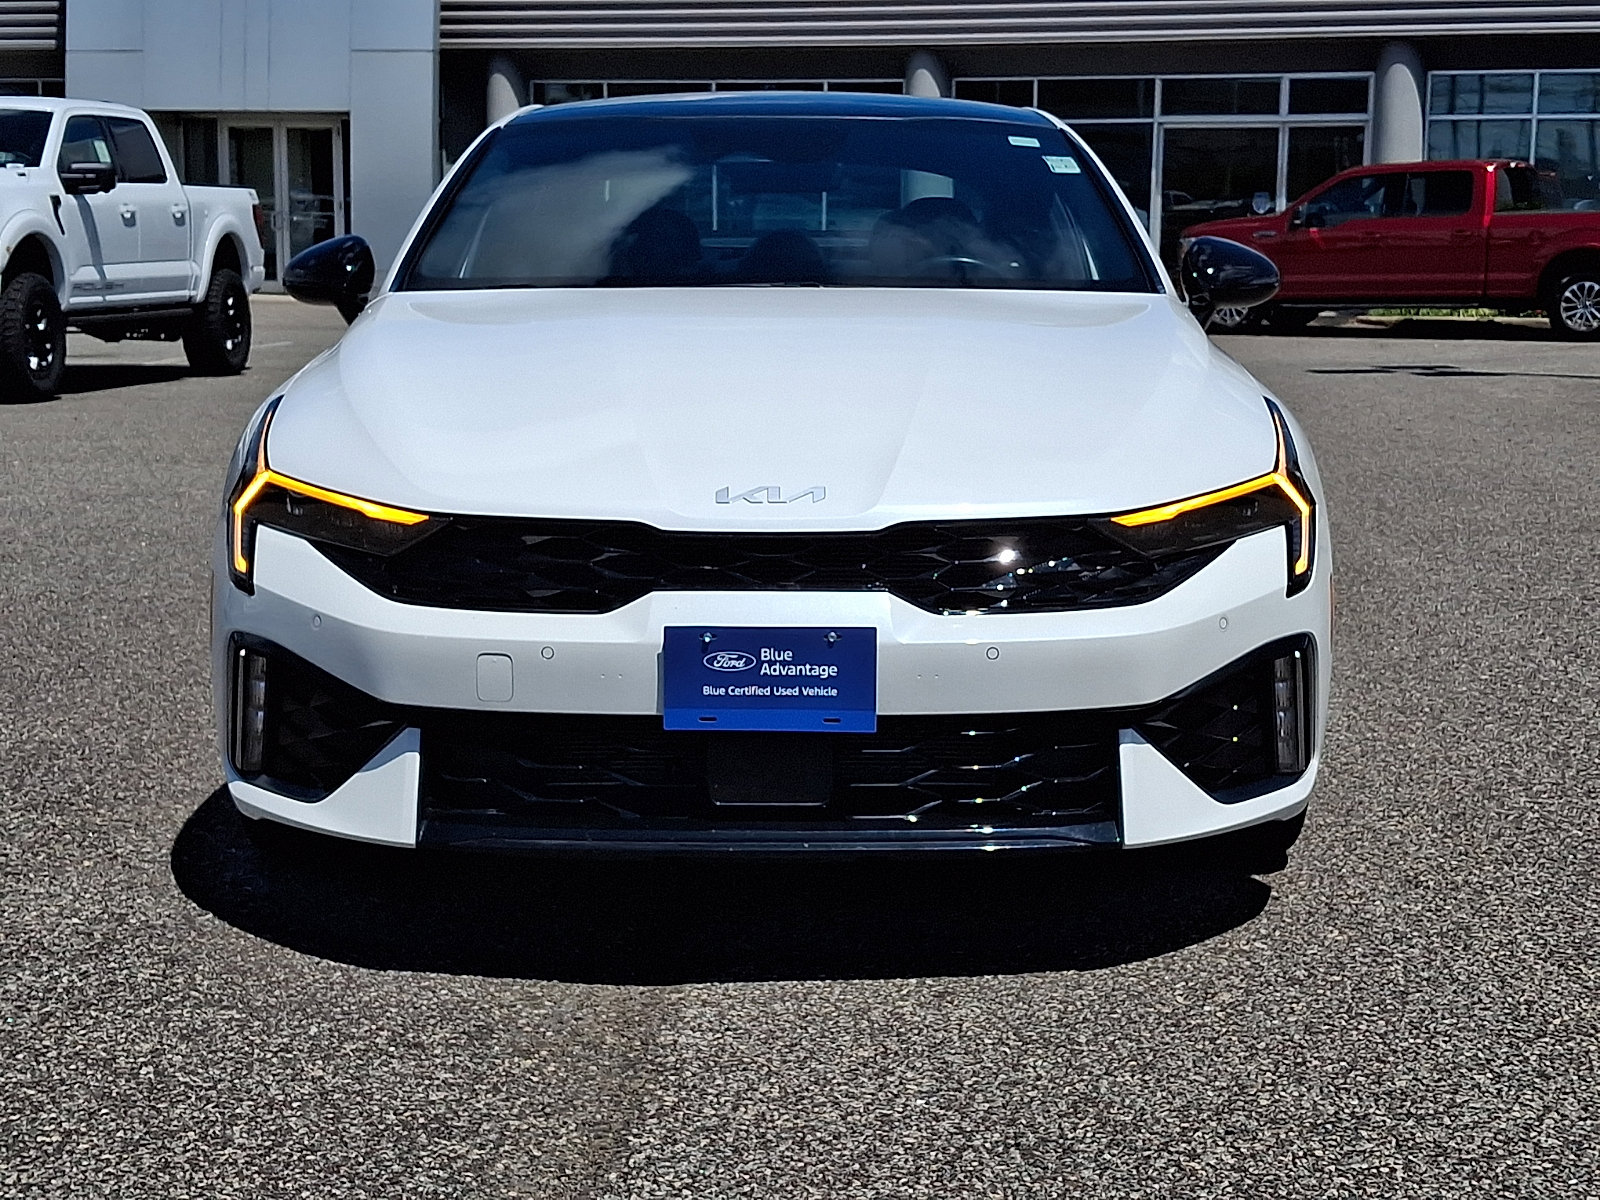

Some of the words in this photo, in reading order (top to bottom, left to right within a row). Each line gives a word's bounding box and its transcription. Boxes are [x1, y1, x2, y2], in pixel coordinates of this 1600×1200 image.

[715, 486, 826, 504] KIA
[713, 653, 747, 668] Ford
[760, 647, 793, 661] Blue
[760, 662, 838, 679] Advantage
[702, 685, 726, 696] Blue
[728, 685, 771, 696] Certified
[773, 685, 799, 696] Used
[801, 685, 838, 697] Vehicle
